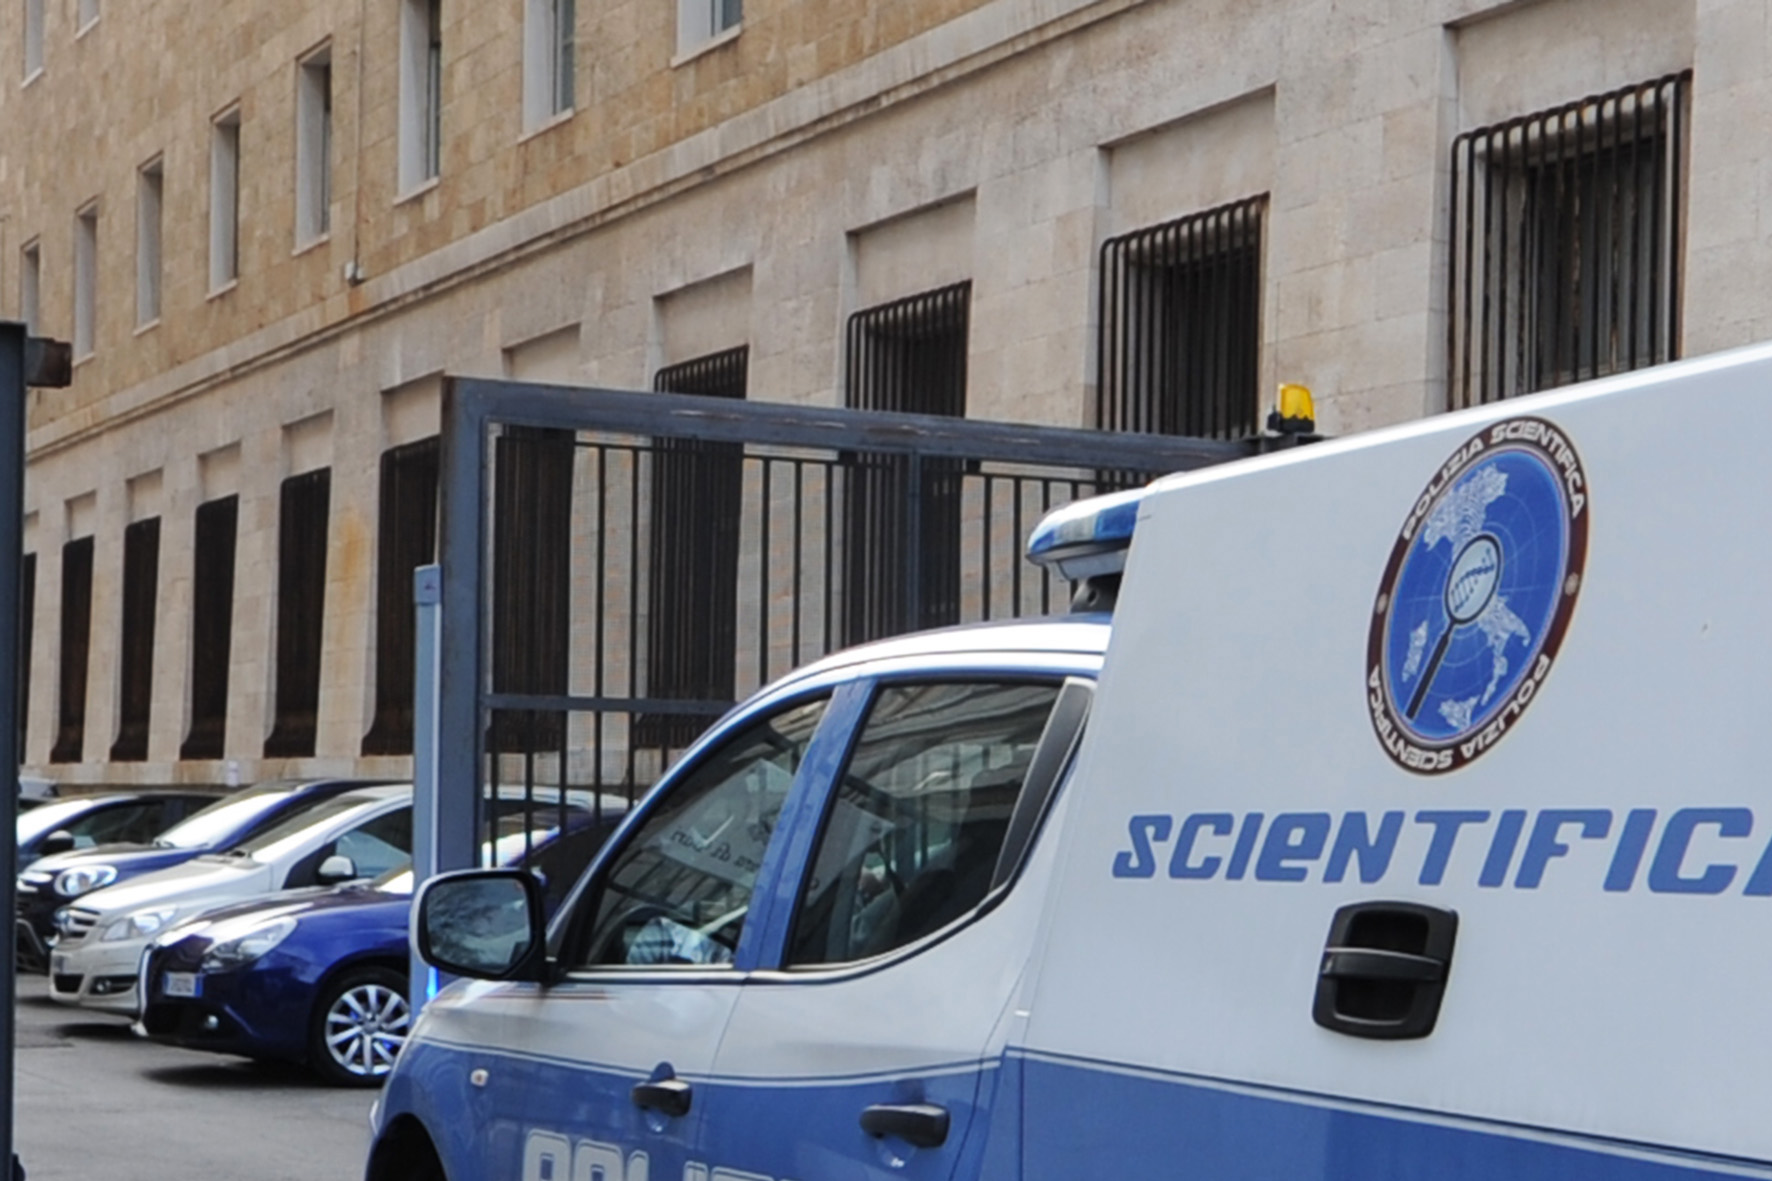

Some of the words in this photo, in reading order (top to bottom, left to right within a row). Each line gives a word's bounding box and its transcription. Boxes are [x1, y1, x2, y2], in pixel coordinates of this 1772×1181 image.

[1403, 438, 1483, 540] POLIZIA
[1490, 420, 1584, 518] SCIENTIFICA
[1369, 664, 1453, 771] SCIENTIFICA
[1463, 653, 1550, 759] POLIZIA
